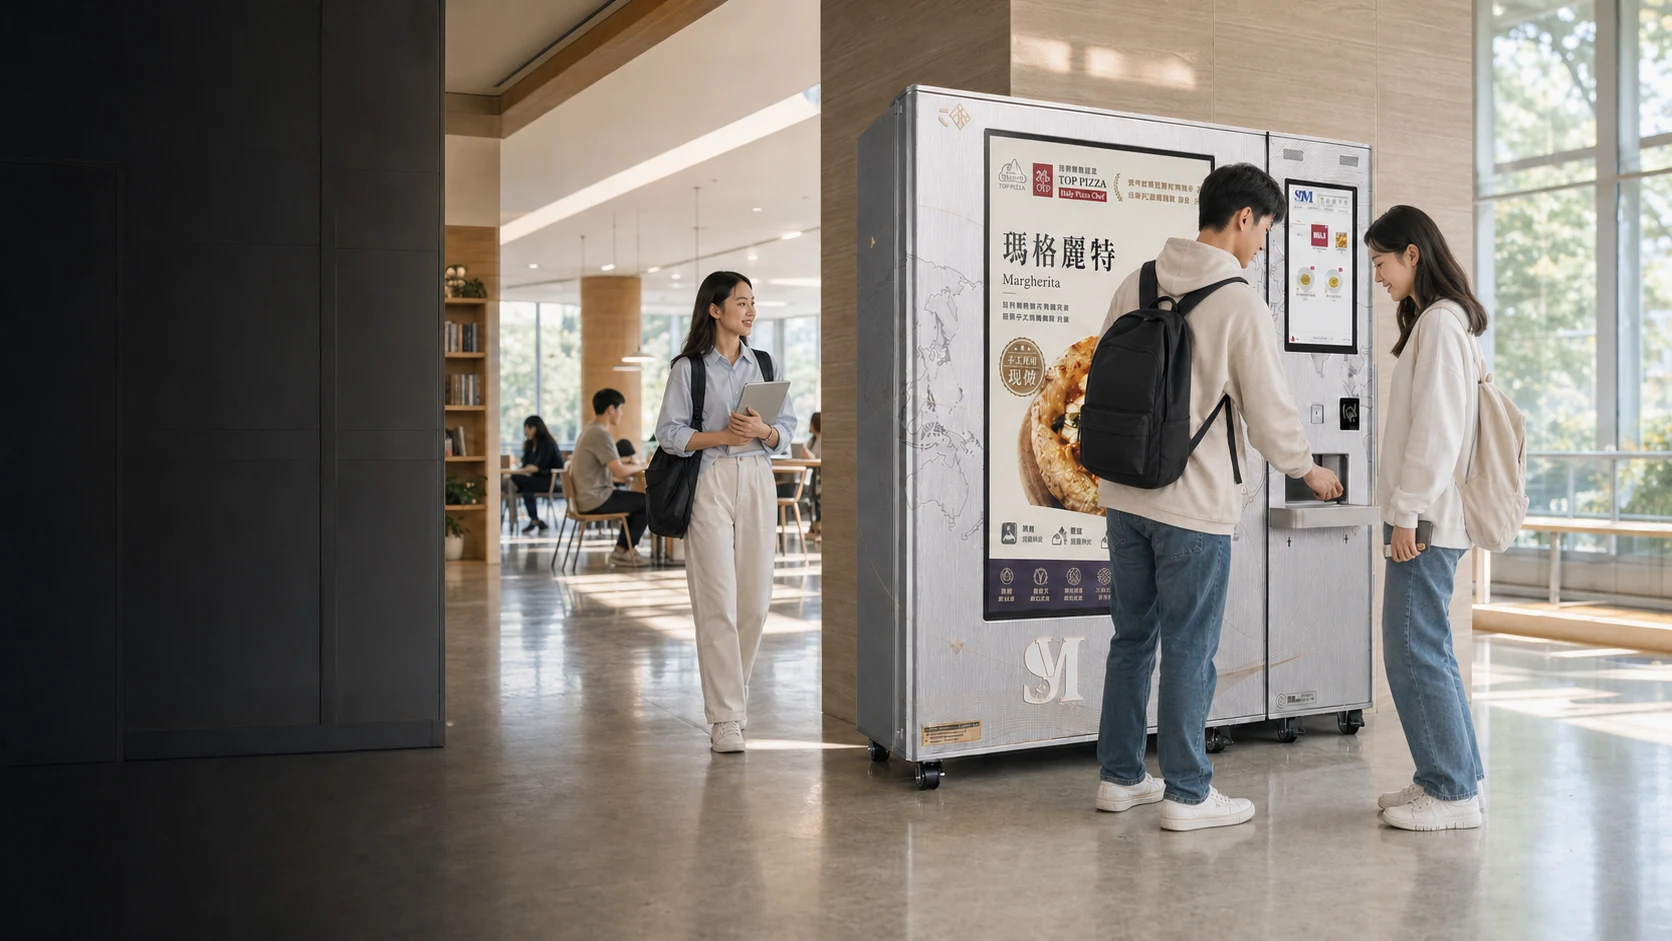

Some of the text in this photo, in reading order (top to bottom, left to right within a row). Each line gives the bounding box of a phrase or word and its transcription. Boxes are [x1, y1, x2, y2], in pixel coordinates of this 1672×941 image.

[1059, 175, 1077, 186] TOP
[1079, 177, 1107, 189] PIZZA
[1075, 190, 1091, 199] Pizza
[1003, 231, 1116, 272] 瑪格麗特
[1002, 273, 1061, 290] Margherita
